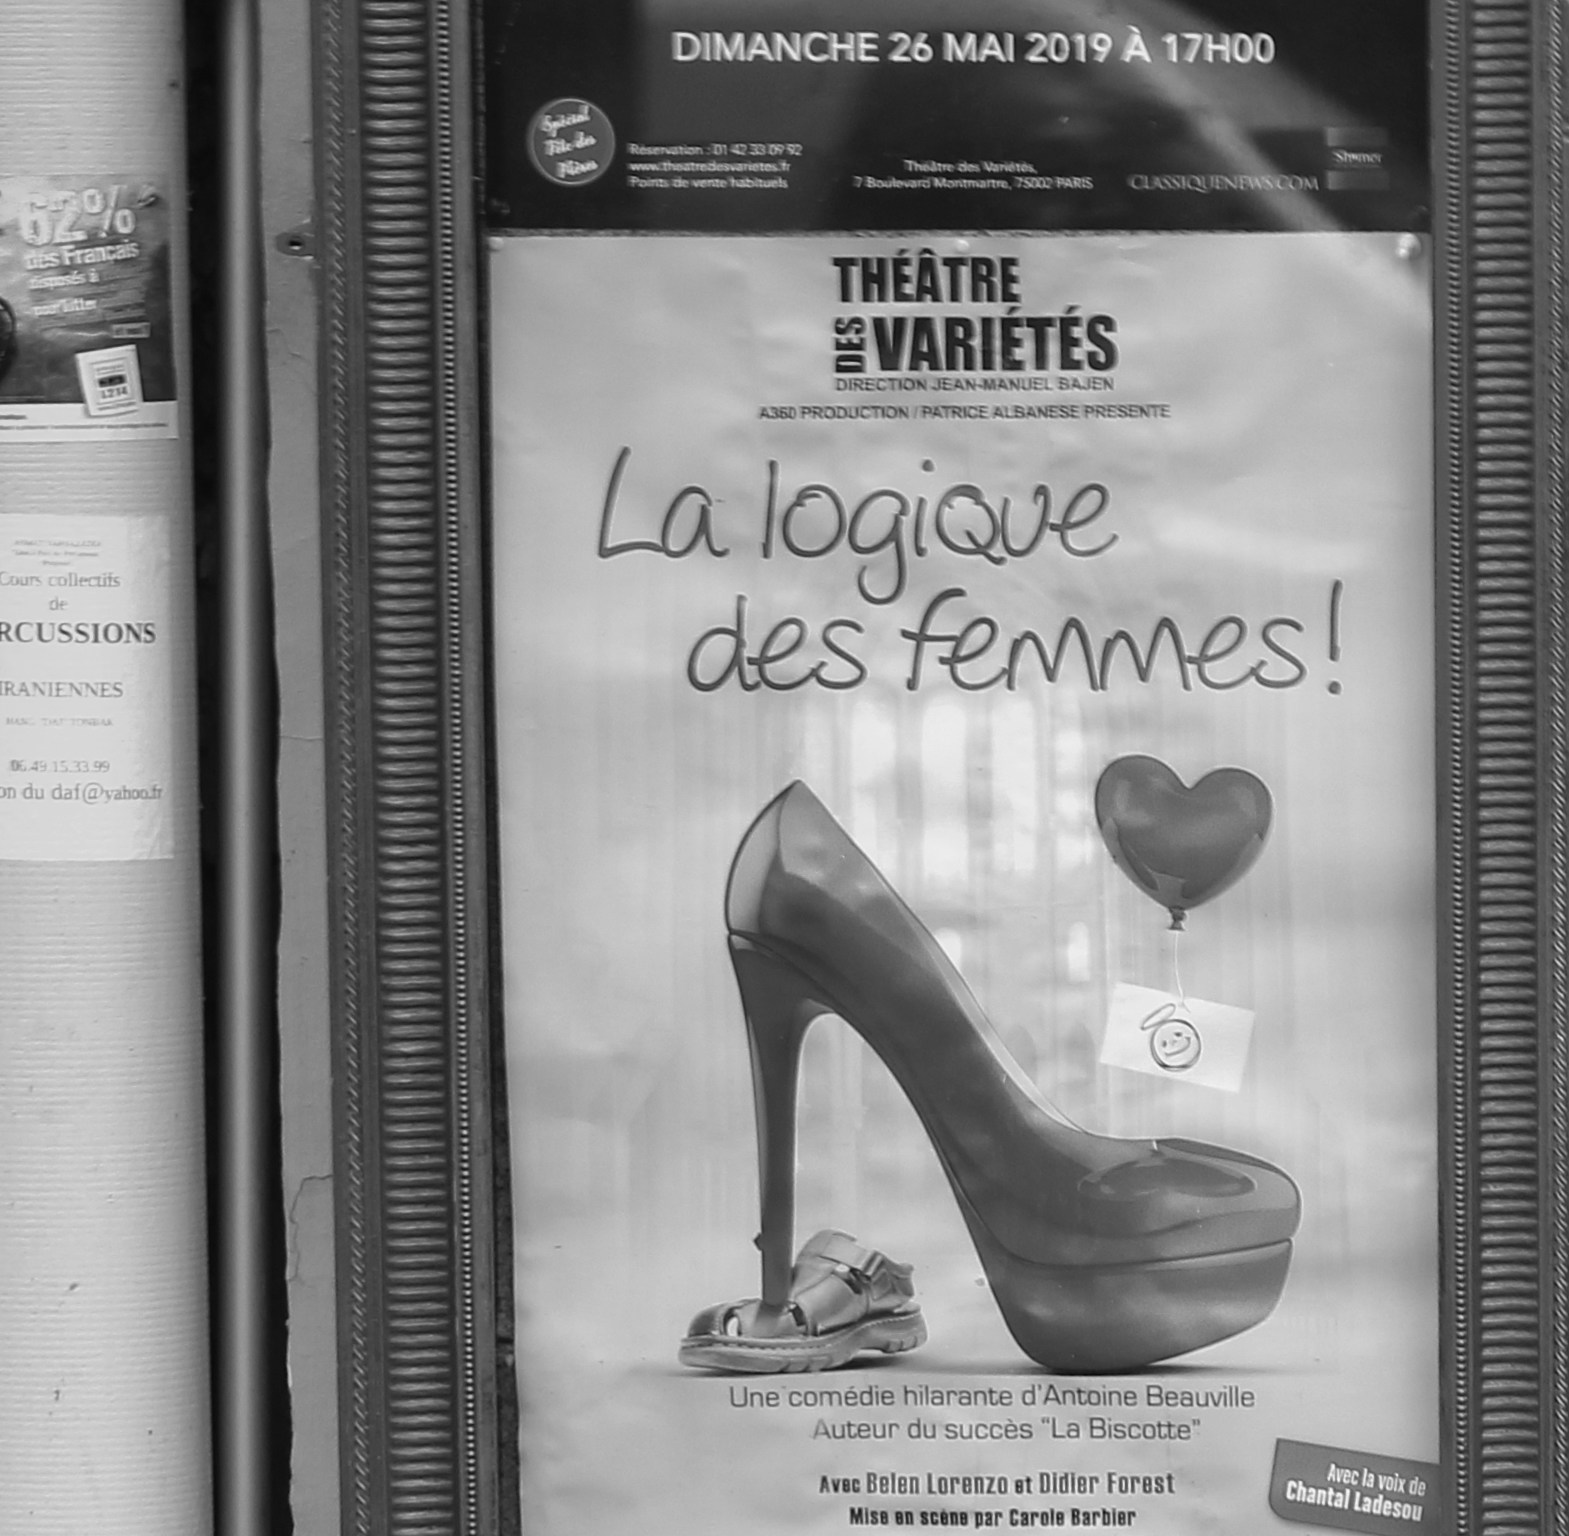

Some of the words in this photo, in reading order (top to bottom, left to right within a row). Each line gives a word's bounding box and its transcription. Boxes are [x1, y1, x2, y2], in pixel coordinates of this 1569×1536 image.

[671, 30, 880, 62] DIMANCHE
[887, 30, 934, 62] 26
[942, 30, 1015, 62] MAI
[1024, 31, 1113, 62] 2019
[1119, 24, 1152, 62] À
[1161, 31, 1276, 63] 17H00
[957, 160, 981, 173] des
[627, 176, 669, 189] Points
[672, 176, 689, 189] de
[691, 178, 728, 189] vente
[730, 176, 789, 189] habituels
[852, 176, 863, 188] 7
[865, 176, 932, 189] Boulevard
[1014, 177, 1053, 190] 75002
[1055, 177, 1095, 190] PARIS
[832, 246, 1023, 304] THÉÂTRE
[834, 315, 868, 374] DES
[872, 304, 1120, 373] VARIÉTÉS
[835, 377, 929, 393] DIRECTION
[931, 377, 1054, 393] JEAN-MANUEL
[1057, 377, 1116, 393] BAJEN
[801, 404, 908, 421] PRODUCTION
[921, 405, 989, 421] PATRICE
[993, 405, 1081, 421] ALBANESE
[597, 445, 730, 559] La
[761, 458, 1119, 605] logique
[0, 570, 42, 587] Cours
[48, 571, 121, 588] collectifs
[49, 597, 68, 611] de
[0, 621, 157, 645] RCUSSIONS
[686, 594, 869, 693] des
[22, 783, 45, 800] du
[729, 1385, 781, 1408] Une
[788, 1384, 896, 1408] comédie
[903, 1384, 1014, 1408] hilarante
[1021, 1383, 1139, 1408] d'Antoine
[1145, 1384, 1256, 1408] Beauville
[811, 1417, 900, 1441] Auteur
[907, 1417, 937, 1440] du
[944, 1418, 1034, 1440] succès
[819, 1475, 861, 1495] Avec
[866, 1471, 921, 1496] Belen
[926, 1472, 1009, 1496] Lorenzo
[1014, 1476, 1033, 1496] et
[1039, 1471, 1100, 1496] Didier
[1106, 1471, 1176, 1496] Forest
[1326, 1463, 1360, 1487] Avec
[1362, 1467, 1375, 1489] la
[1378, 1471, 1406, 1494] voix
[1409, 1475, 1427, 1497] de
[1285, 1479, 1351, 1511] Chantal
[1353, 1490, 1425, 1523] Ladesou
[849, 1506, 890, 1527] Mise
[895, 1509, 914, 1527] en
[920, 1507, 969, 1527] scène
[974, 1510, 1003, 1530] par
[1009, 1507, 1065, 1528] Carole
[1070, 1507, 1137, 1528] Barbier
